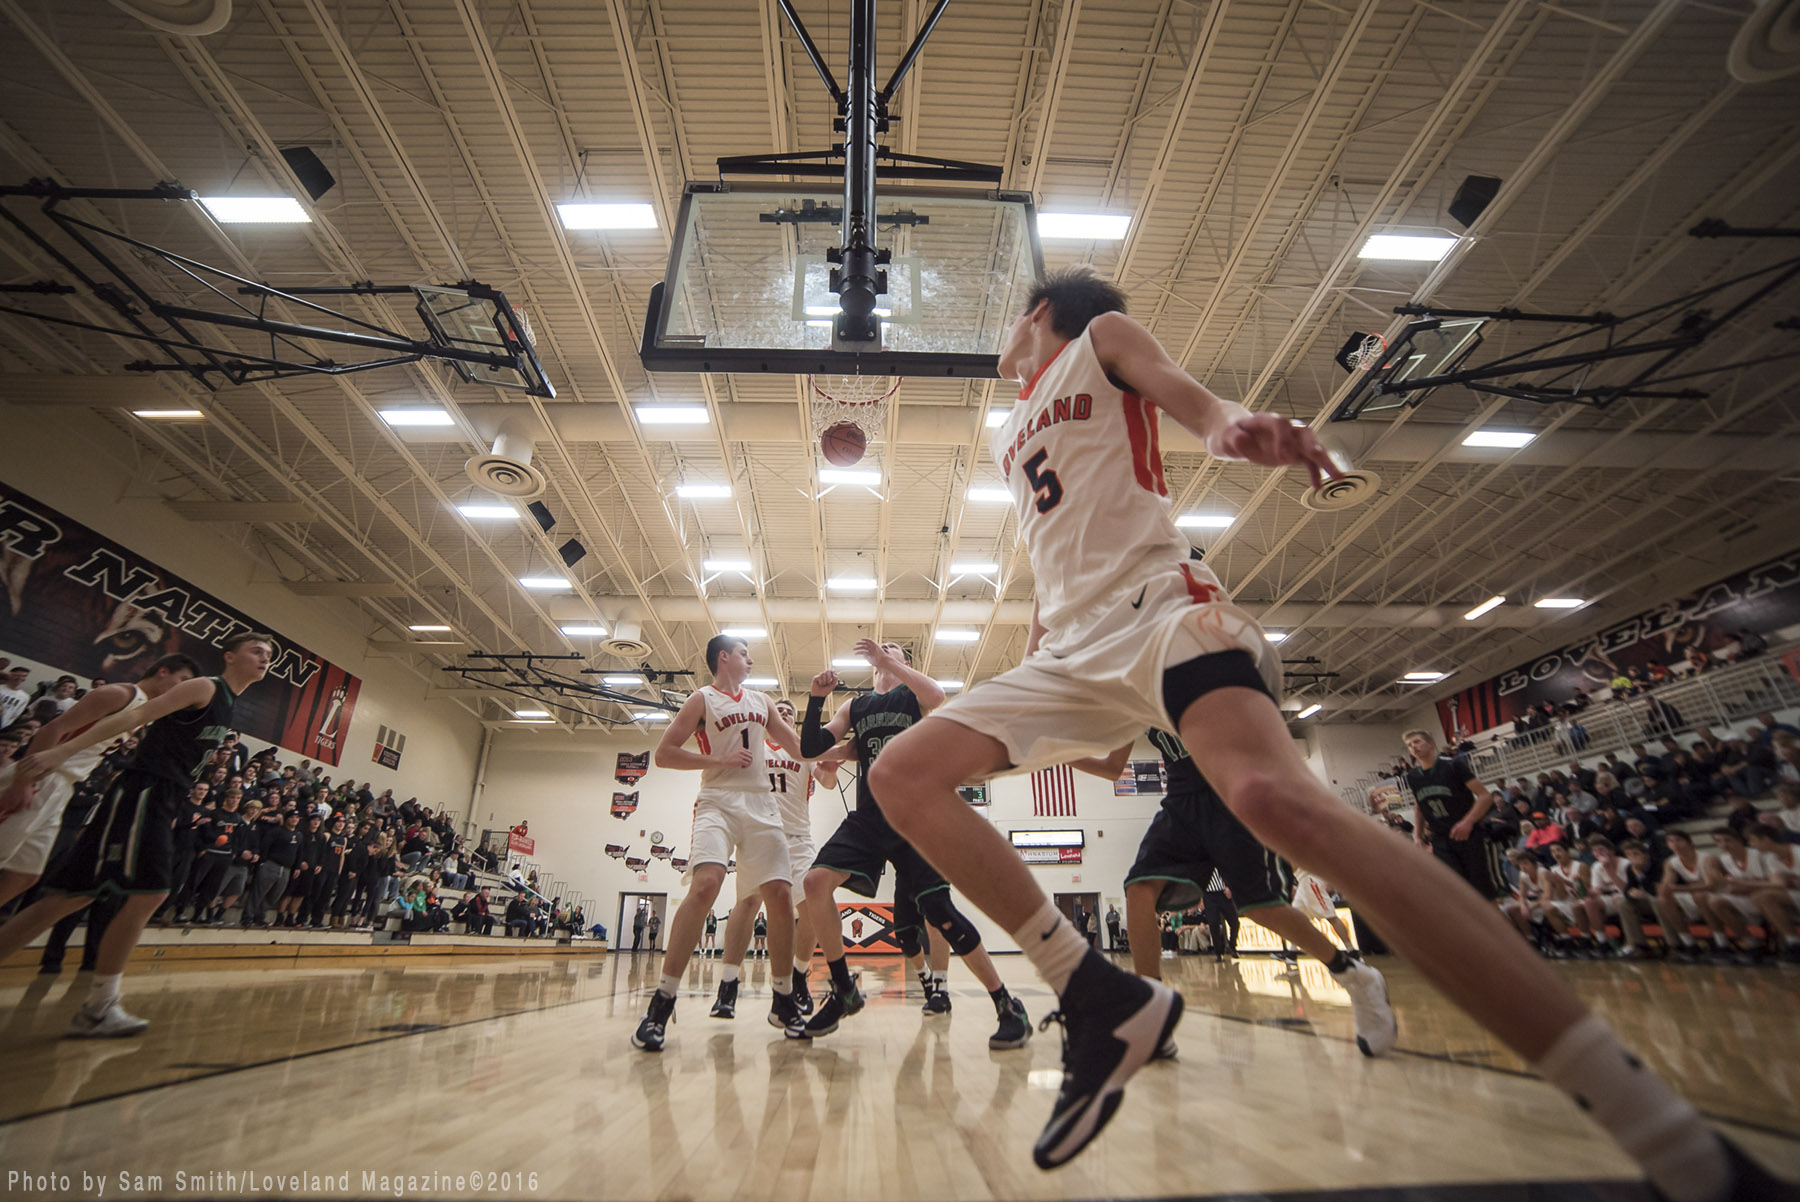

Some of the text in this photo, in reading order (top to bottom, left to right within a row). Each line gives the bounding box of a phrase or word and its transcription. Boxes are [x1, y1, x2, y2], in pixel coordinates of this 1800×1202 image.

[1003, 394, 1093, 484] OVELAND
[1022, 446, 1064, 514] 5
[64, 547, 320, 688] NATIN
[314, 735, 337, 750] TIGERS
[867, 735, 894, 766] 3
[765, 759, 801, 773] ELAND
[769, 773, 787, 793] 11
[868, 911, 886, 924] TIGERS
